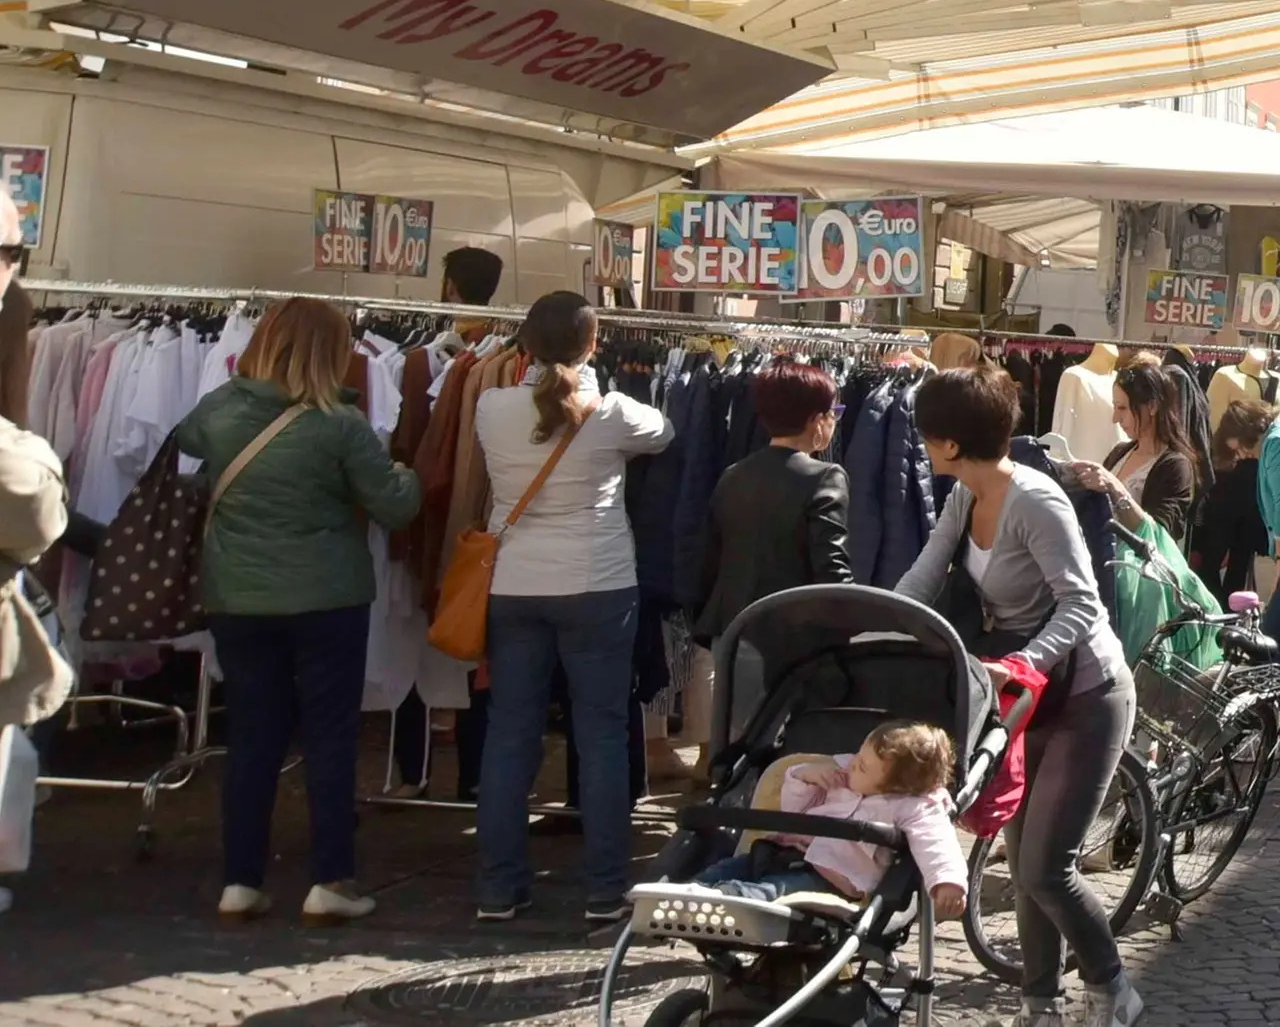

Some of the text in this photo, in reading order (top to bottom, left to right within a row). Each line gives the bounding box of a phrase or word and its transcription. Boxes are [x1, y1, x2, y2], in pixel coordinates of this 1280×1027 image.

[452, 8, 691, 98] Dreams
[325, 197, 367, 230] FINE
[682, 200, 774, 240] FINE
[857, 209, 917, 236] €uro
[321, 232, 369, 266] SERIE
[672, 245, 781, 285] SERIE
[1159, 275, 1214, 301] FINE
[1153, 299, 1216, 326] SERIE
